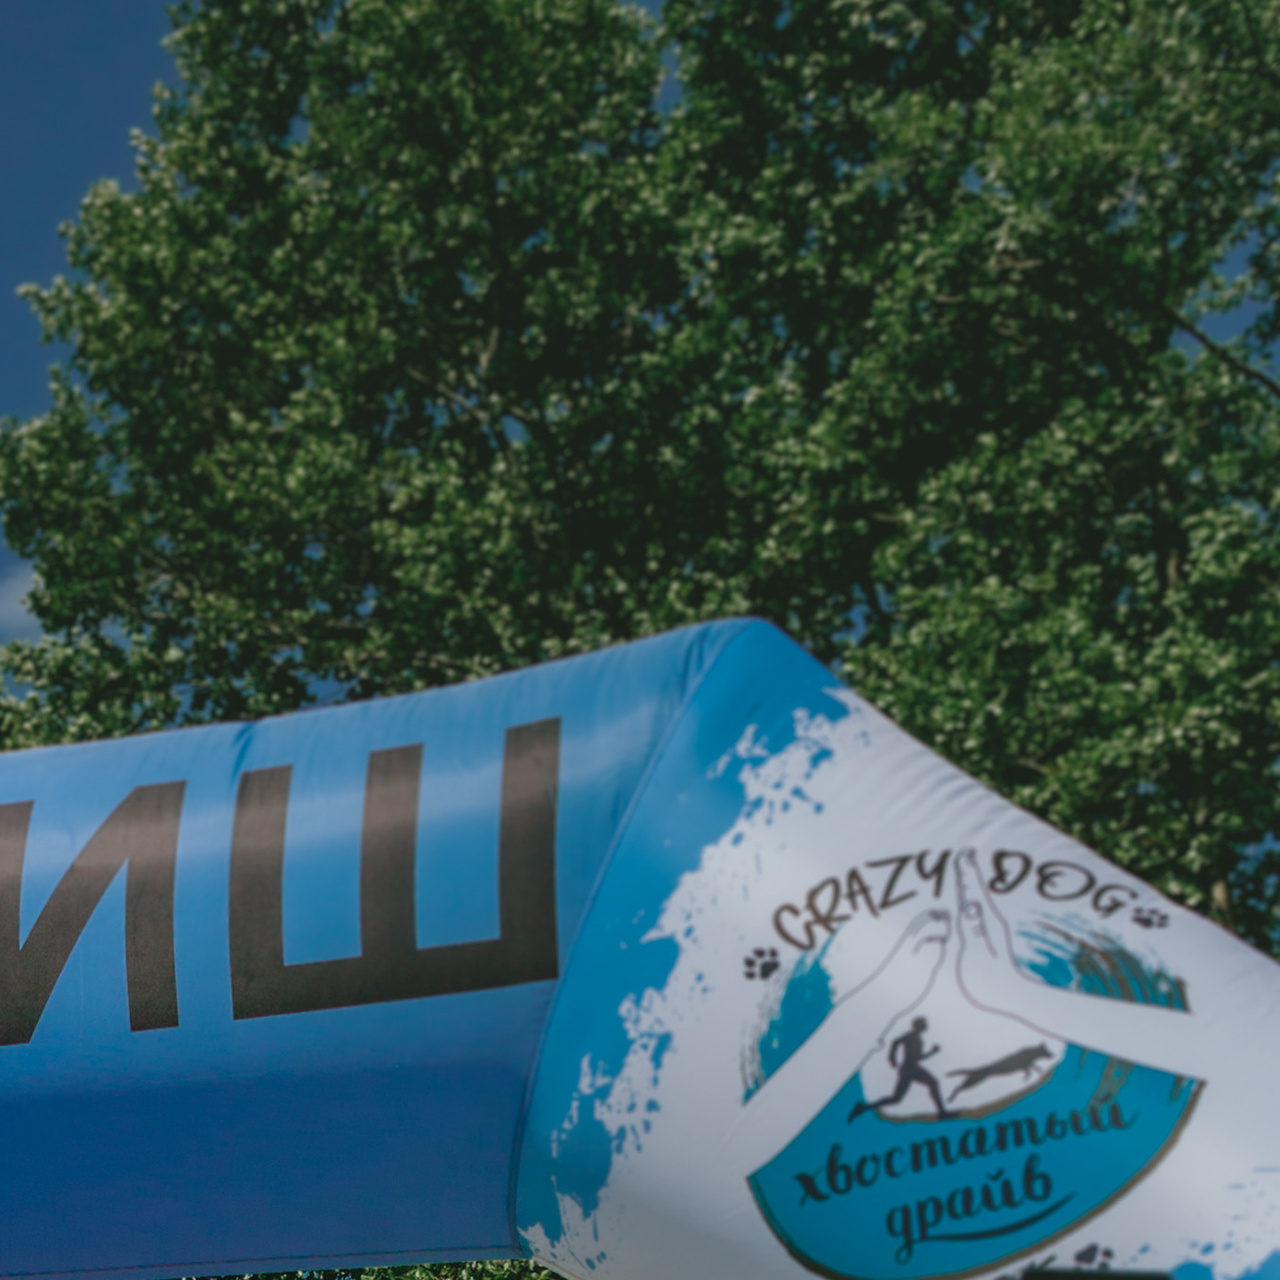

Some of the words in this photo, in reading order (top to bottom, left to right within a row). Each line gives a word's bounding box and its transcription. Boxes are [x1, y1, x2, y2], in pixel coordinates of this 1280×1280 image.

[771, 849, 954, 953] CRAZY
[988, 849, 1140, 921] DOG
[794, 1102, 1140, 1208] хвостатый
[885, 1154, 1054, 1266] драйв
